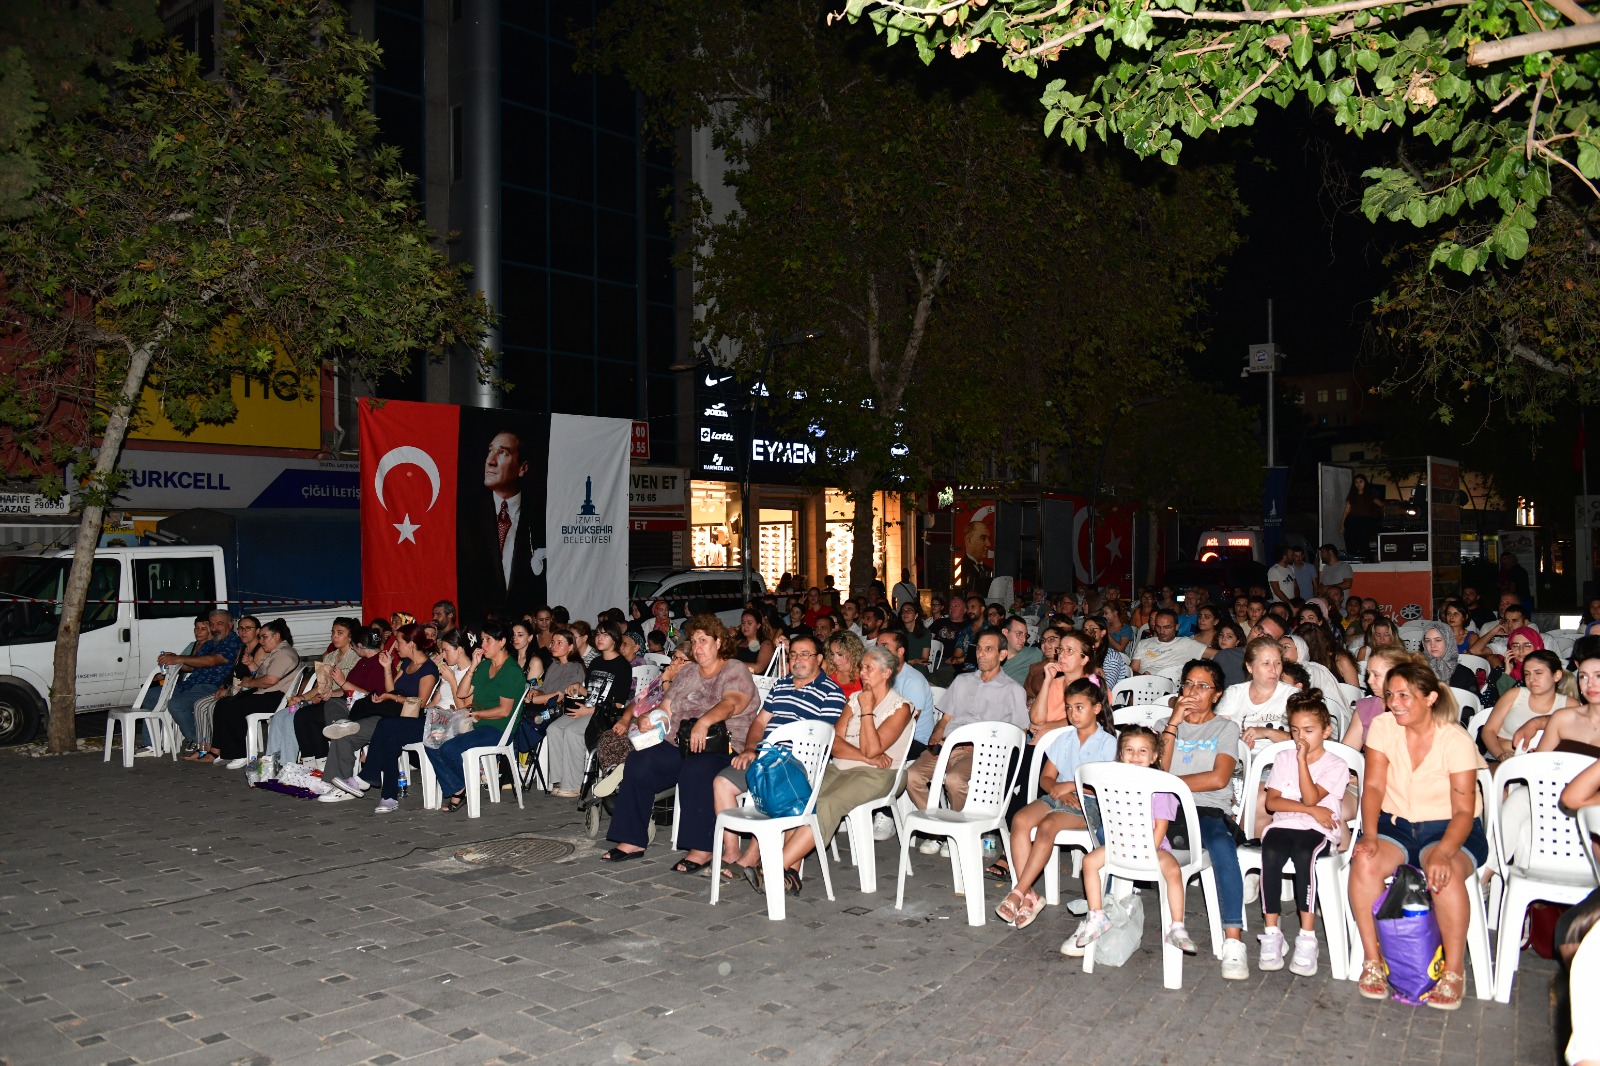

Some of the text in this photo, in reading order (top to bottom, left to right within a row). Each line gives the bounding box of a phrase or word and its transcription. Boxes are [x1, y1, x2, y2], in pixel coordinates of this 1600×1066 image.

[636, 441, 646, 454] 55
[630, 474, 678, 489] VEN ET
[301, 484, 331, 499] ÇİĞLİ
[647, 493, 657, 502] 65
[575, 515, 601, 524] İZMİR
[561, 524, 614, 535] BÜYÜKŞEHİR
[634, 521, 648, 530] ET
[563, 535, 612, 544] BELEDİYESİ
[1227, 538, 1250, 547] YARDIM
